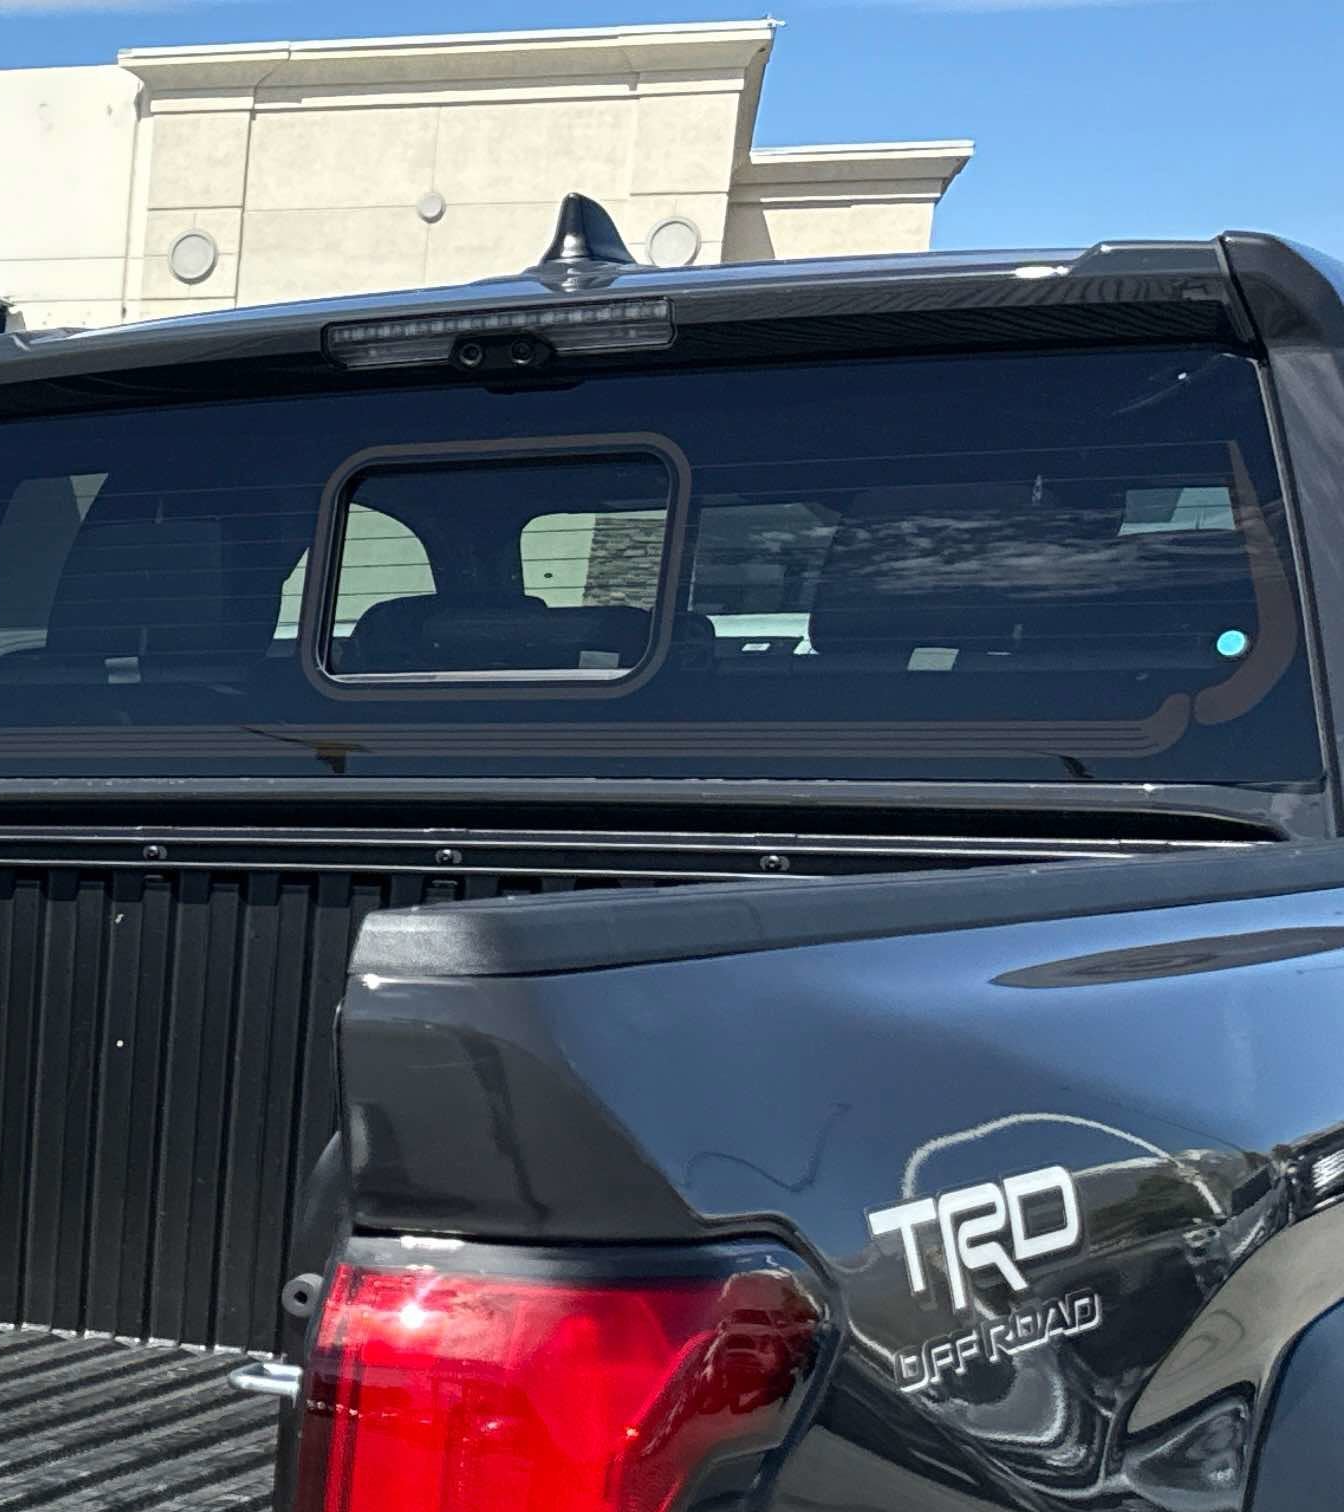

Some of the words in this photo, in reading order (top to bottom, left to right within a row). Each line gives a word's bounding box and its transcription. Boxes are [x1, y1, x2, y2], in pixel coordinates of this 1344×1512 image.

[868, 1166, 1080, 1311] TRD
[893, 1330, 979, 1393] OFF
[980, 1289, 1102, 1363] ROAD
